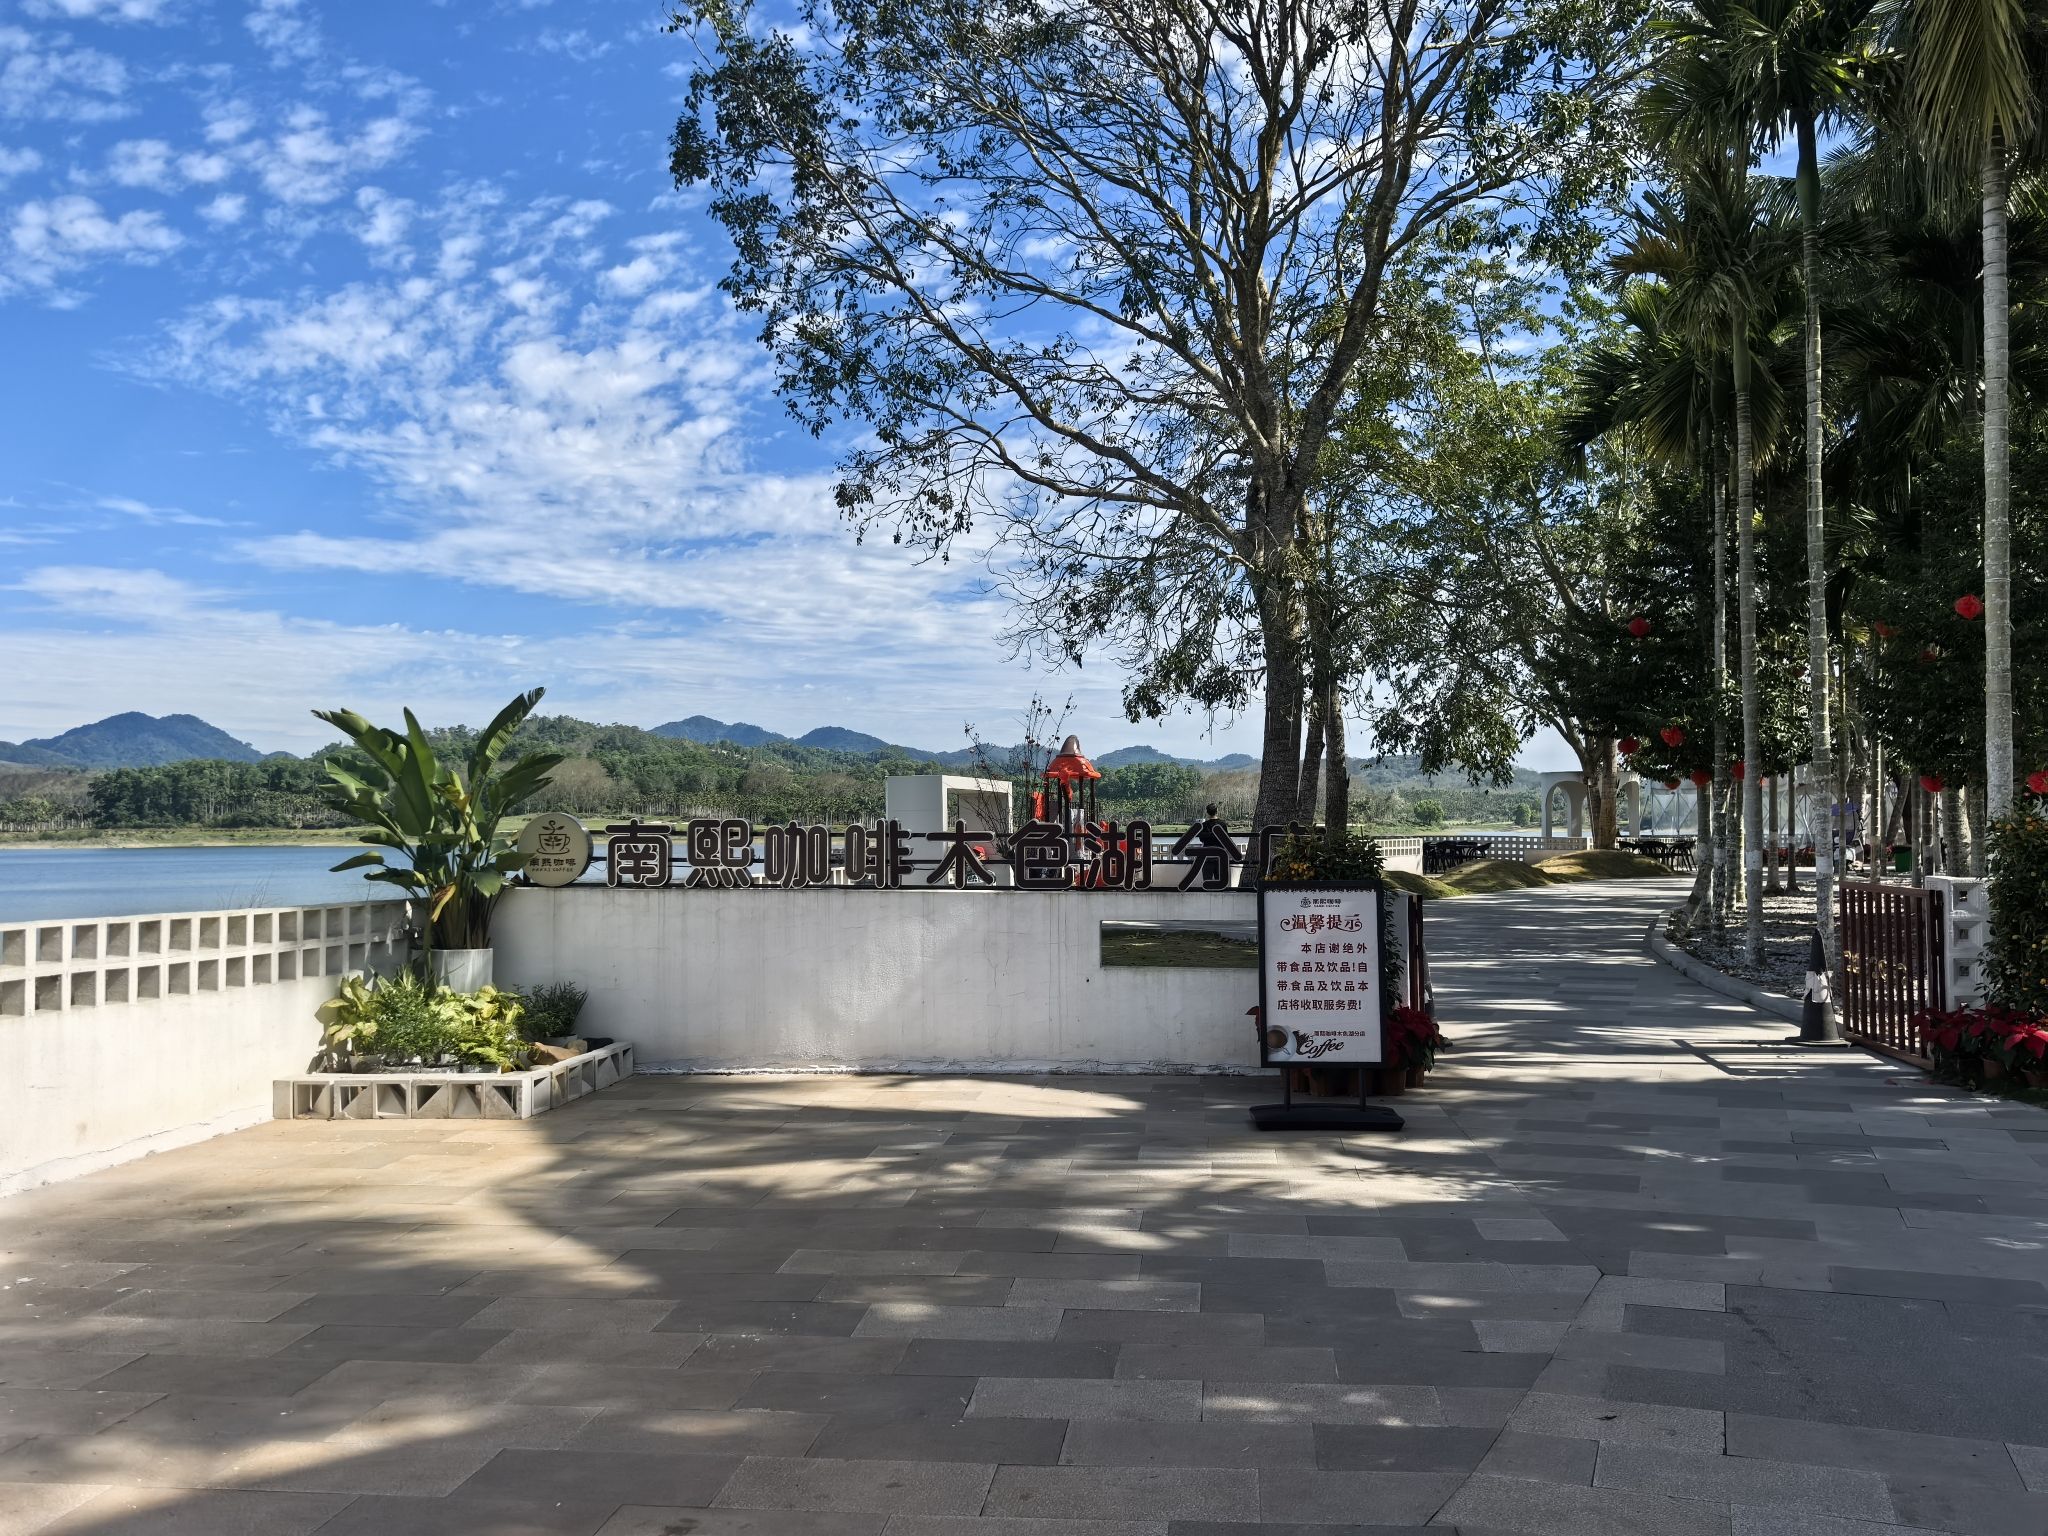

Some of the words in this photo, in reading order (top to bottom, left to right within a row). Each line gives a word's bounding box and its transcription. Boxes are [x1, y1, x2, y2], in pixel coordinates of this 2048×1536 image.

[1281, 913, 1362, 934] 温馨提示
[1301, 942, 1368, 954] 本店谢绝外
[1277, 961, 1368, 973] 带食品及饮品!自
[1277, 980, 1369, 992] 带食品及饮品本
[1277, 999, 1362, 1011] 店将收取服务费!
[1297, 1038, 1345, 1058] Coffee
